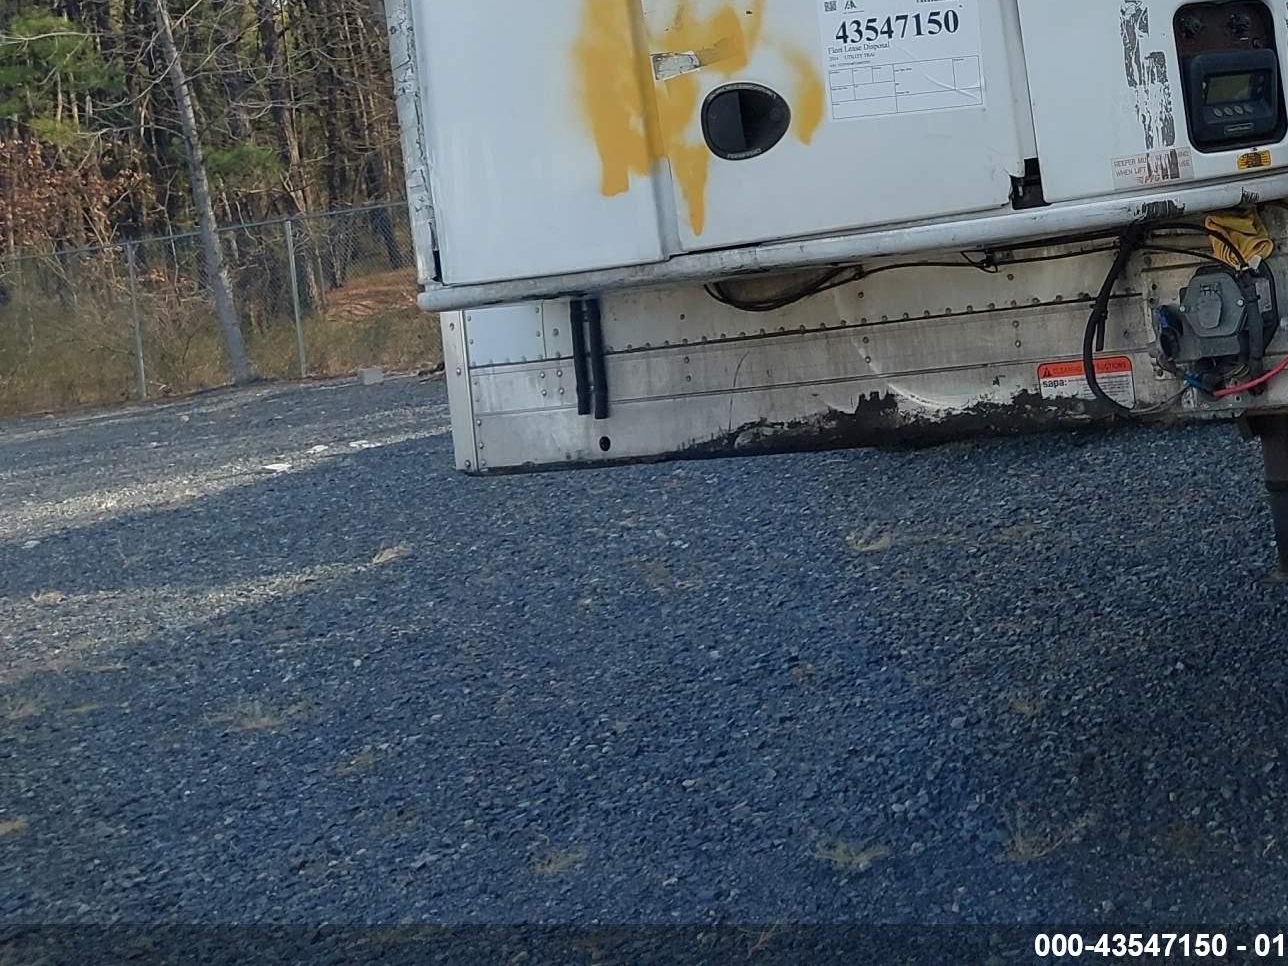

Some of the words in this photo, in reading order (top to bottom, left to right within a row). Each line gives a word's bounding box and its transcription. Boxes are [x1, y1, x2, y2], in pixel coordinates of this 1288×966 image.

[835, 9, 960, 45] 43547150
[844, 44, 863, 53] Lease
[863, 41, 890, 52] Disposal
